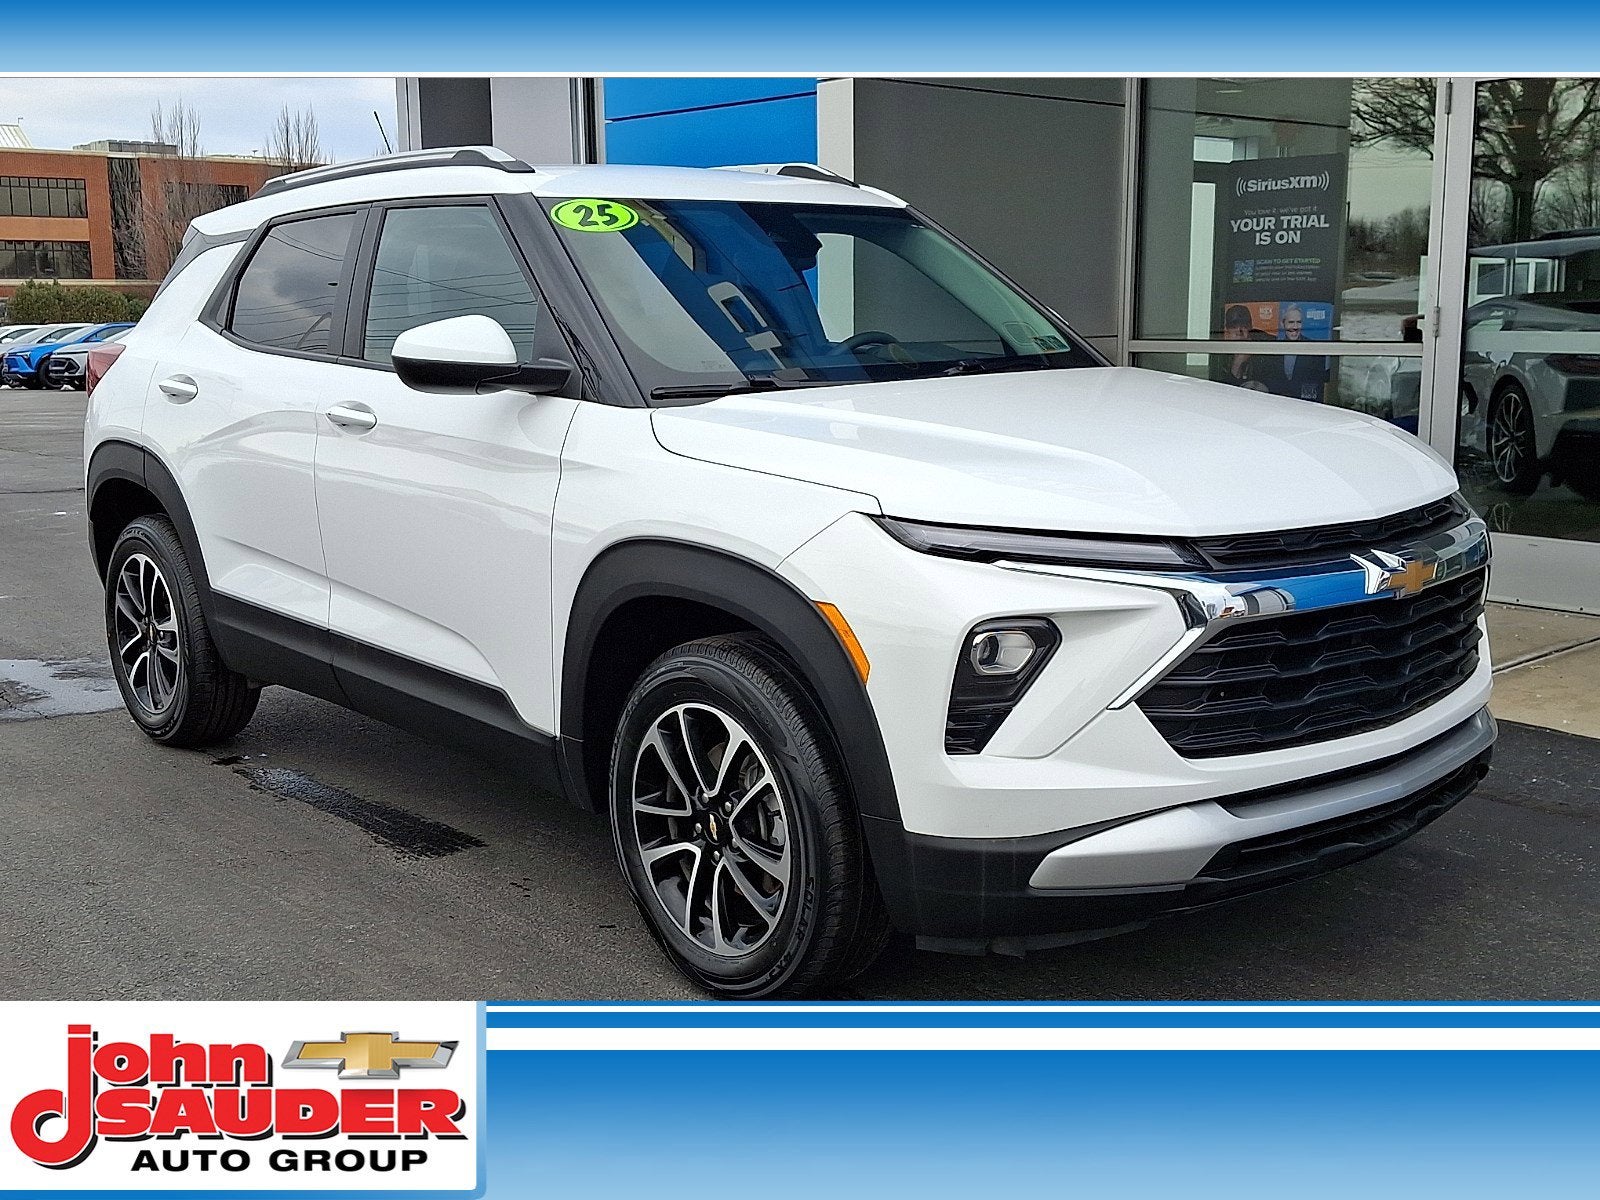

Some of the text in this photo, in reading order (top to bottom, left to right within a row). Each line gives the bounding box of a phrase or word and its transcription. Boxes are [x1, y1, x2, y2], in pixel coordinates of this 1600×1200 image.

[572, 203, 620, 227] 25
[1230, 213, 1330, 233] YOUR TRIAL
[1255, 230, 1301, 246] IS ON
